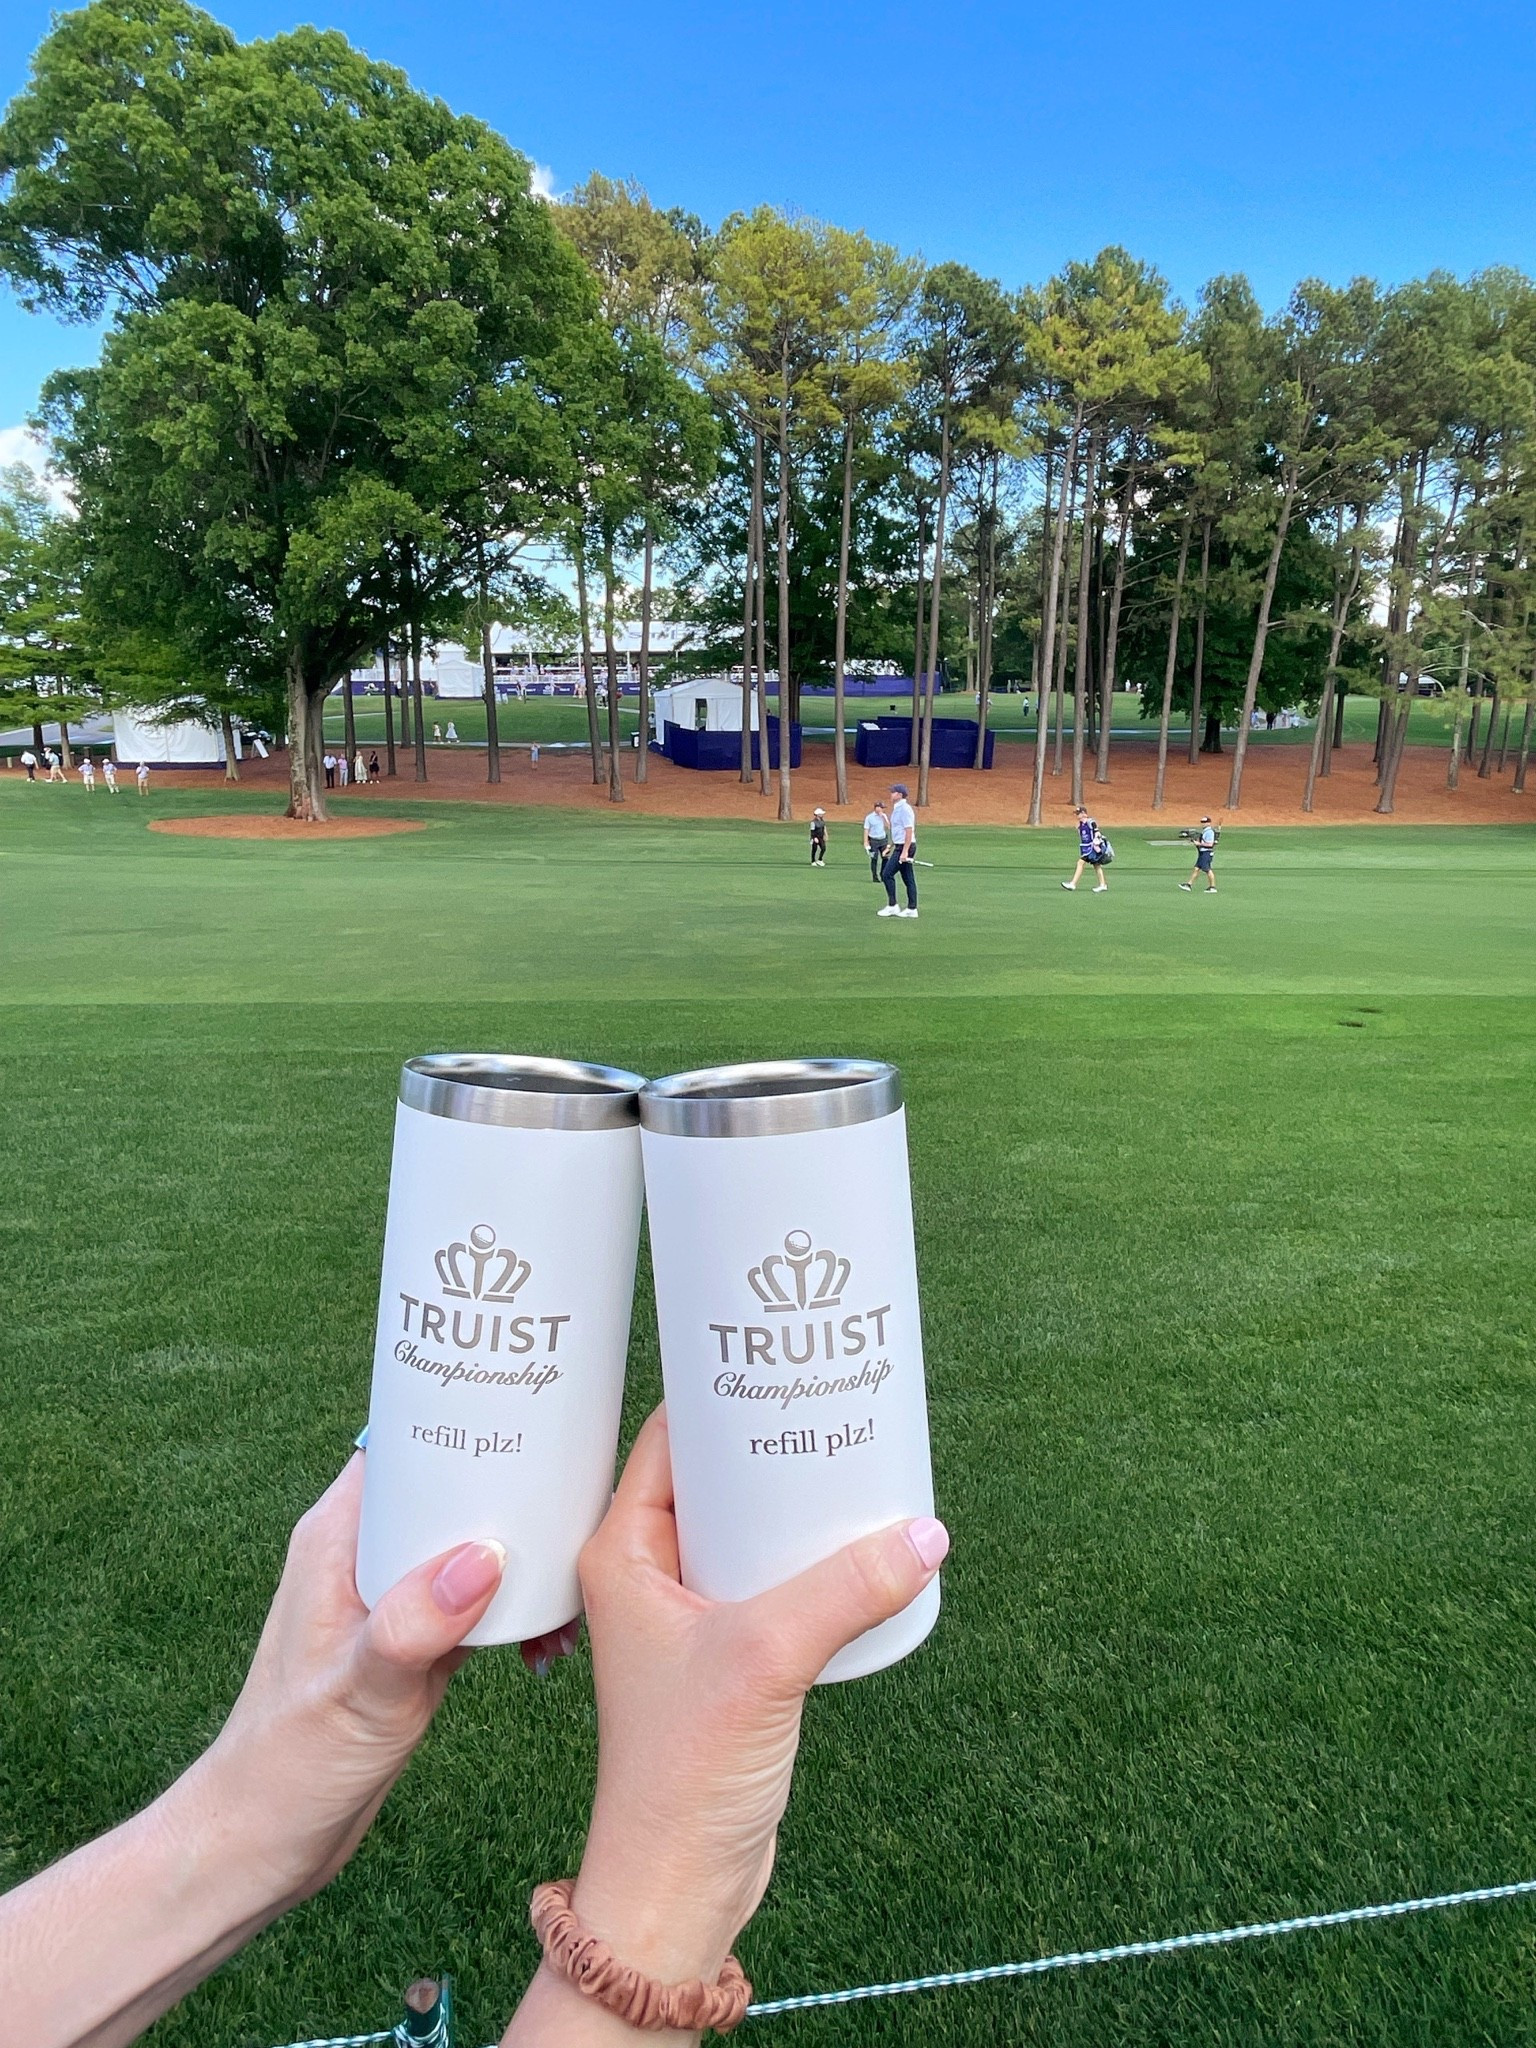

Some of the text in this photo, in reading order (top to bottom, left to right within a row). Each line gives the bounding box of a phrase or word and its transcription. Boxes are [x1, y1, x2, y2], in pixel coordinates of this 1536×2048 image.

[399, 1292, 571, 1353] TRUIST
[708, 1304, 891, 1365] TRUIST
[394, 1339, 564, 1395] Championship
[713, 1358, 895, 1410] Championship
[411, 1424, 522, 1457] refill plz!
[749, 1418, 875, 1457] refill plz!
